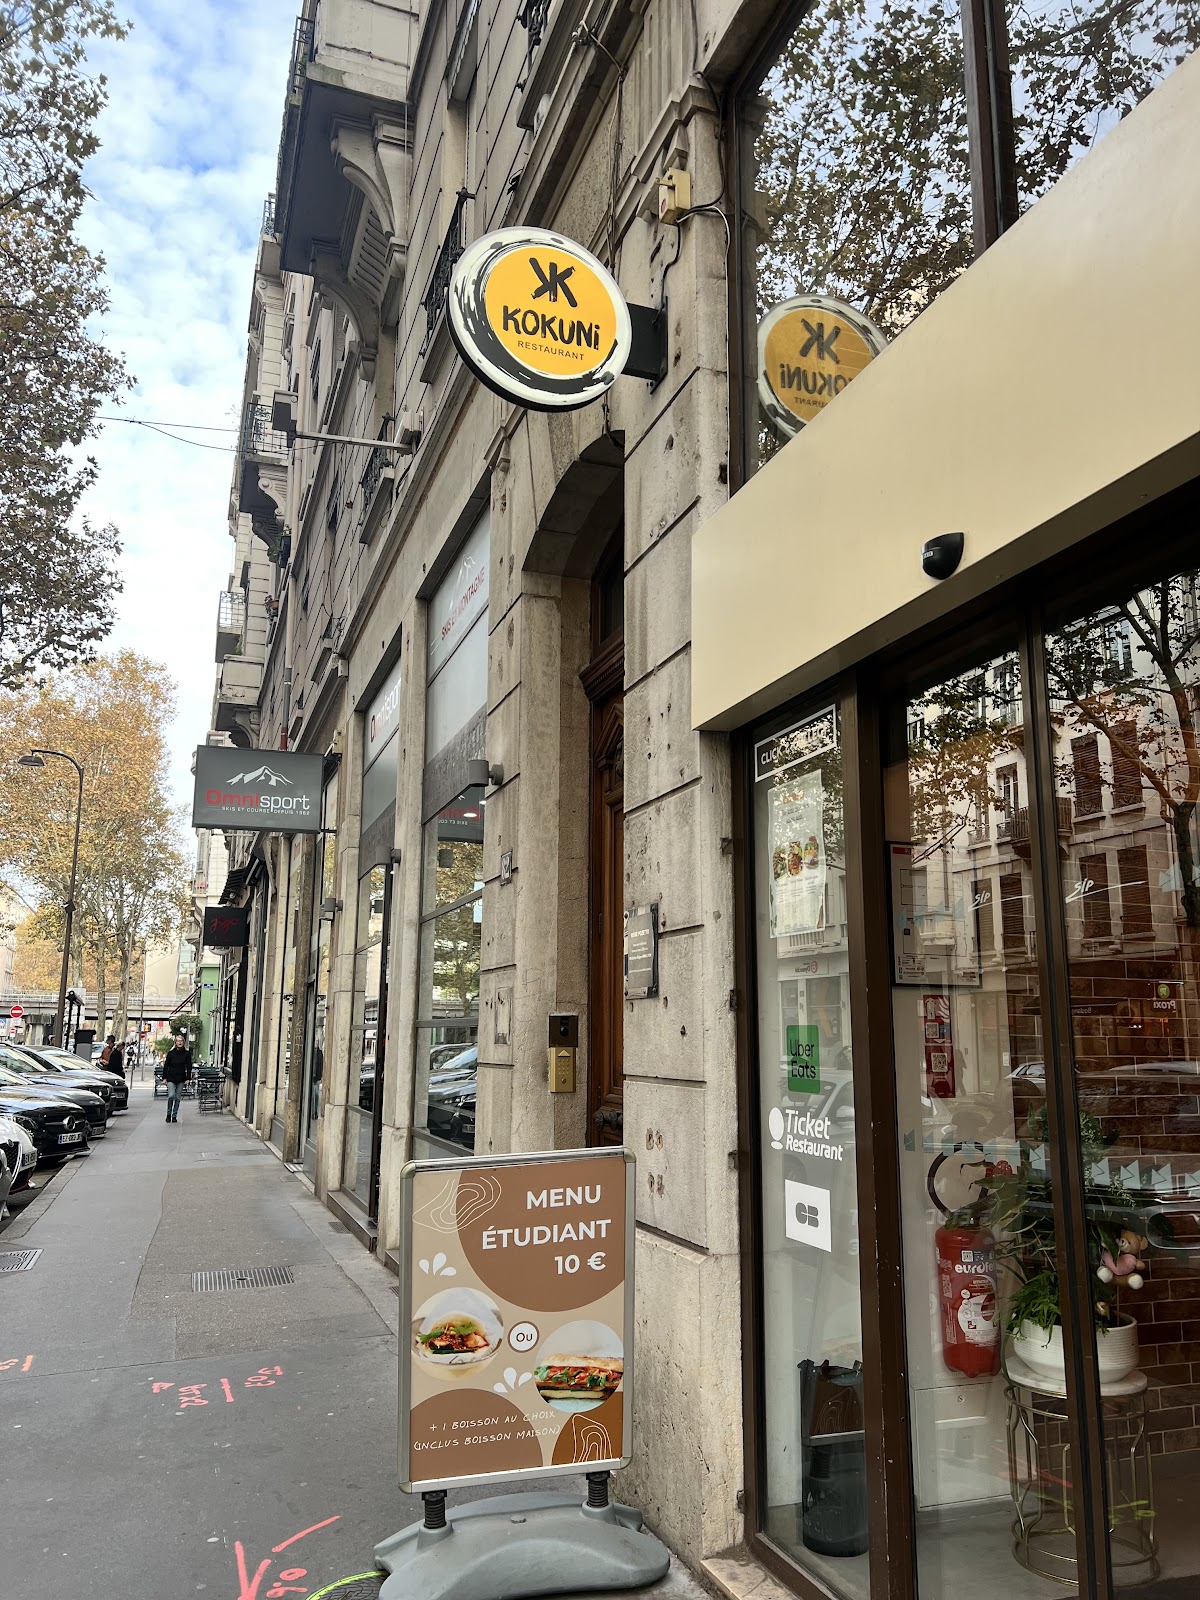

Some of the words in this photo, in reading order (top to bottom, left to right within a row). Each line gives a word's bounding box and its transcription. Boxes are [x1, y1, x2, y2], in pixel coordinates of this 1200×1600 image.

[517, 340, 585, 361] RESTAURANT
[761, 745, 783, 765] CLICK
[206, 789, 310, 812] Omnisport
[790, 1039, 815, 1058] Uber
[791, 1060, 817, 1079] Eats
[786, 1109, 832, 1140] Ticket
[786, 1134, 844, 1161] Restaurant
[526, 1184, 601, 1210] MENU
[482, 1219, 612, 1250] ÉTUDIANT
[554, 1254, 580, 1274] 10
[587, 1252, 606, 1270] €
[452, 1417, 499, 1430] BOISSON
[504, 1415, 517, 1424] AU
[522, 1410, 556, 1422] CHOIX
[464, 1432, 512, 1446] BOISSON
[516, 1425, 562, 1440] MAISON)
